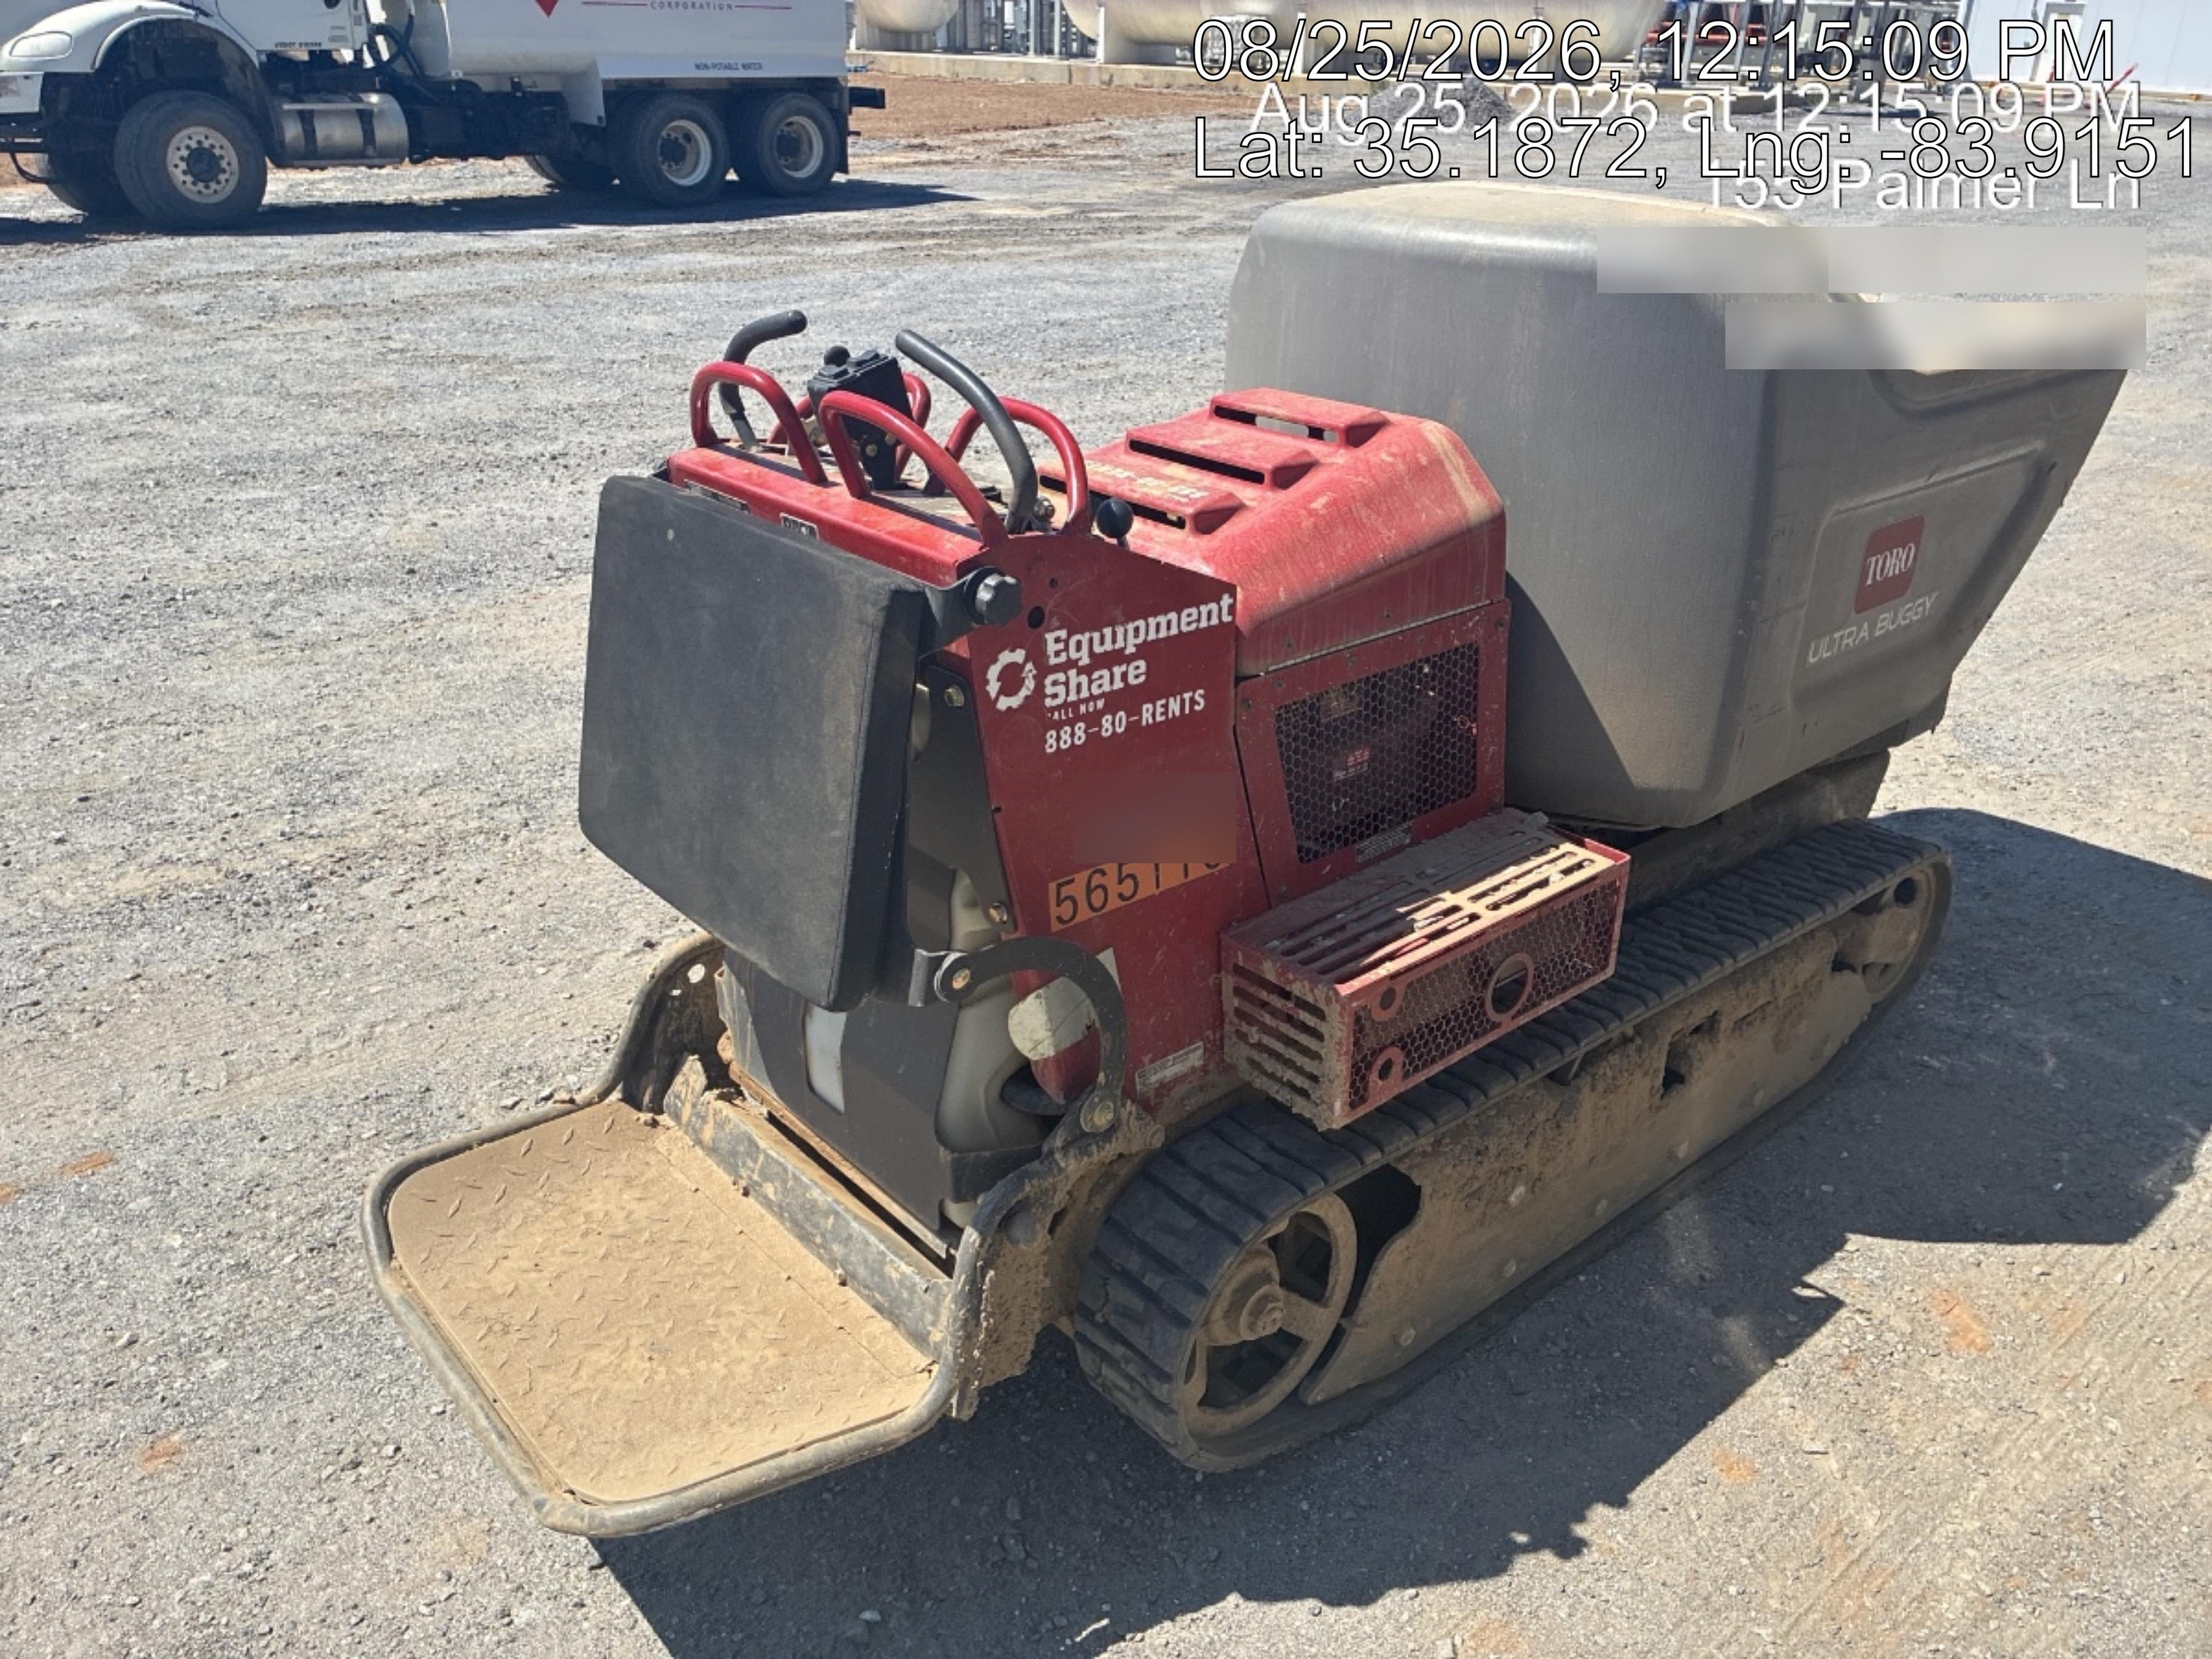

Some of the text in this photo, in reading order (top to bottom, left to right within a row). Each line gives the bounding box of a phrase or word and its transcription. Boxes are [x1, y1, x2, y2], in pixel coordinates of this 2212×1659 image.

[650, 1, 733, 10] CORPORATION
[1865, 543, 1916, 586] TORO
[1045, 594, 1234, 667] Equipment
[1808, 591, 1940, 663] ULTRA BUGGY
[1045, 659, 1147, 708] Share
[1080, 698, 1105, 715] NOW
[1045, 689, 1206, 753] 888-80-RENTS
